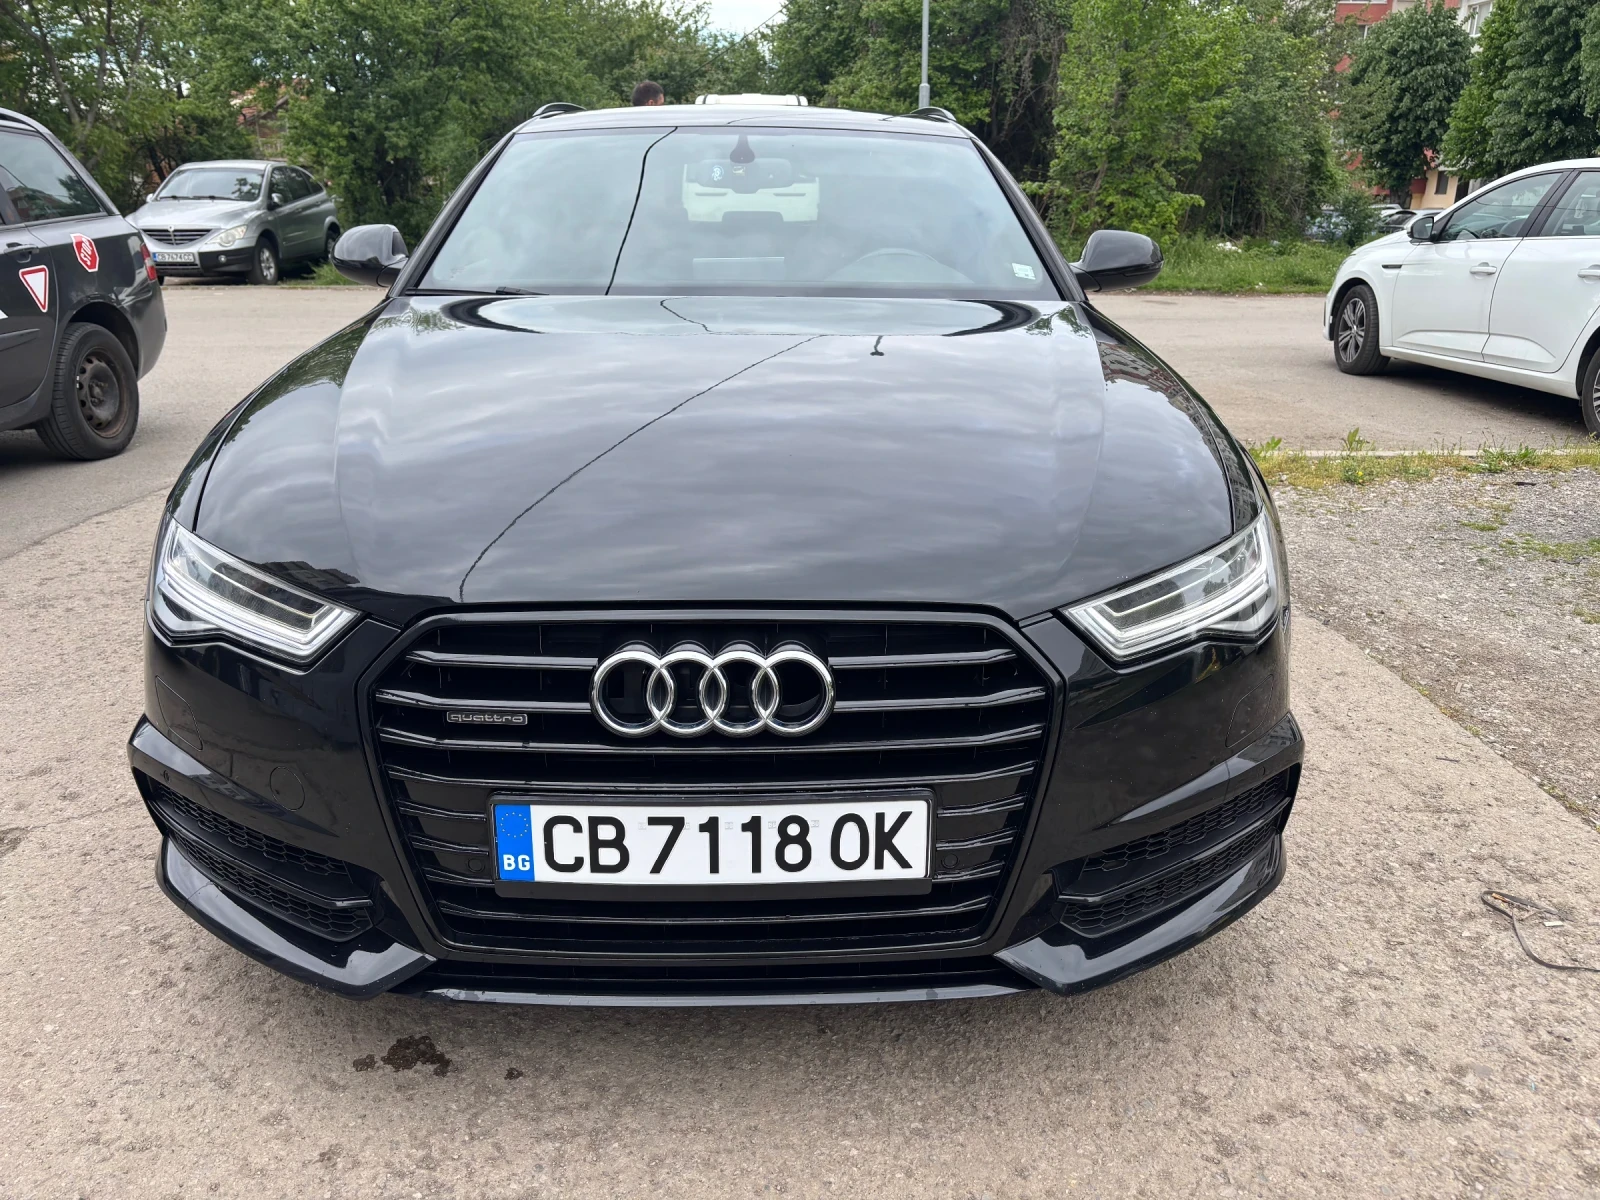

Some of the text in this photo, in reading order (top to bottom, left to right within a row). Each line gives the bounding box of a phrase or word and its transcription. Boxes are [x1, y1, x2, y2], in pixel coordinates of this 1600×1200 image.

[80, 237, 93, 266] STOP
[450, 714, 524, 722] quattro
[543, 811, 913, 874] CB 7118 OK
[503, 854, 531, 871] BG
